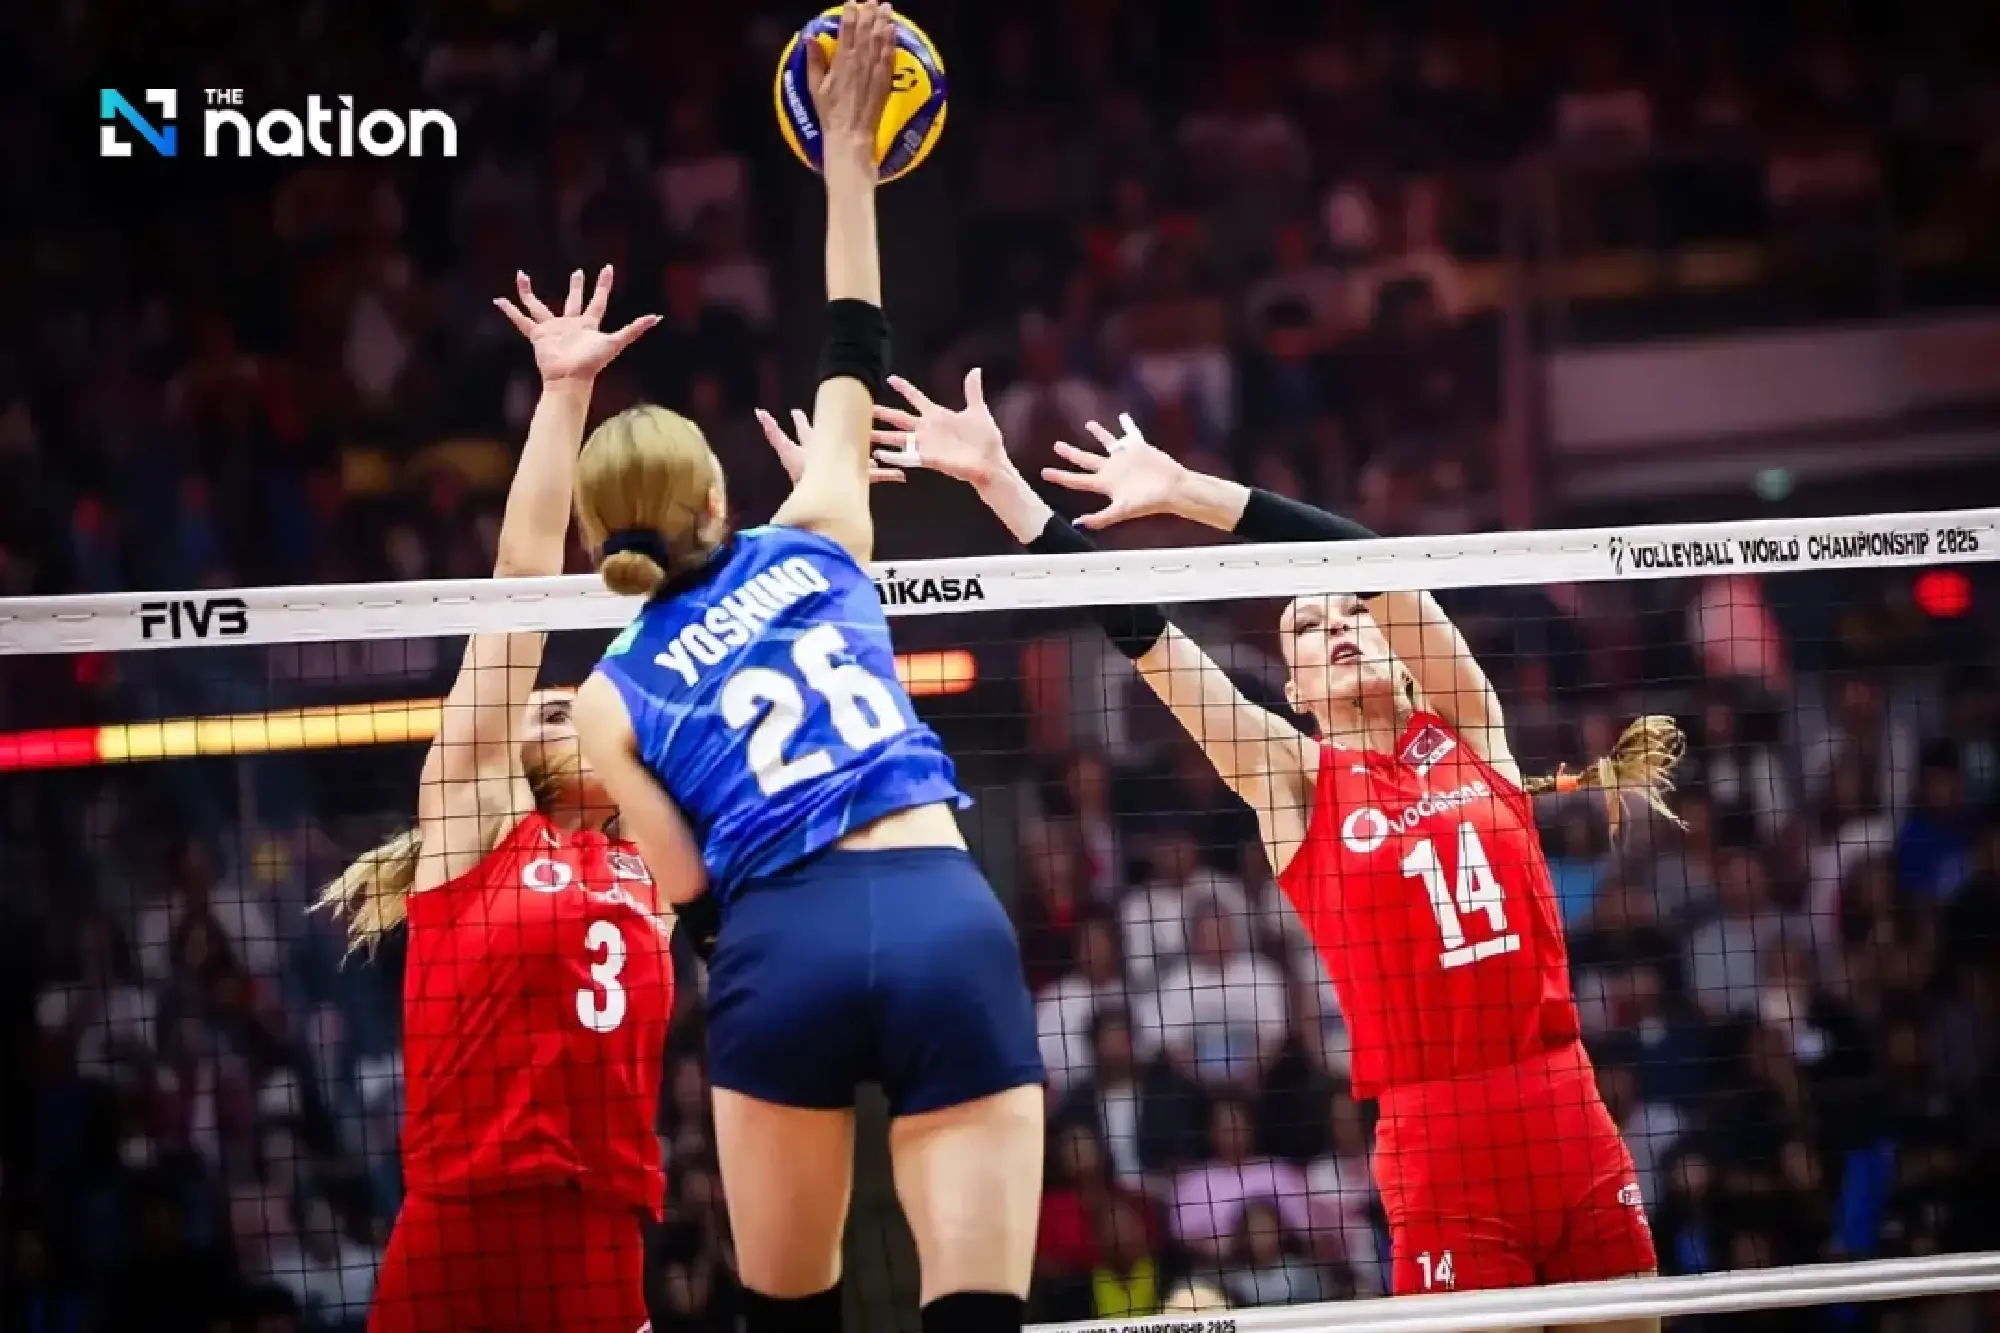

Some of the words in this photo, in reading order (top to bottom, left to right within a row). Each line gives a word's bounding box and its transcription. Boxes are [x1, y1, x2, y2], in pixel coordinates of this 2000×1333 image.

[1630, 541, 1733, 568] VOLLEYBALL
[1739, 538, 1799, 563] WORLD
[1808, 532, 1929, 560] CHAMPIONSHIP
[1937, 529, 1979, 554] 2025
[141, 598, 248, 639] FIVB
[654, 556, 831, 687] YOSHINO
[720, 622, 906, 797] 26
[1401, 822, 1508, 949] 14
[576, 920, 627, 1033] 3
[1417, 1250, 1455, 1289] 14
